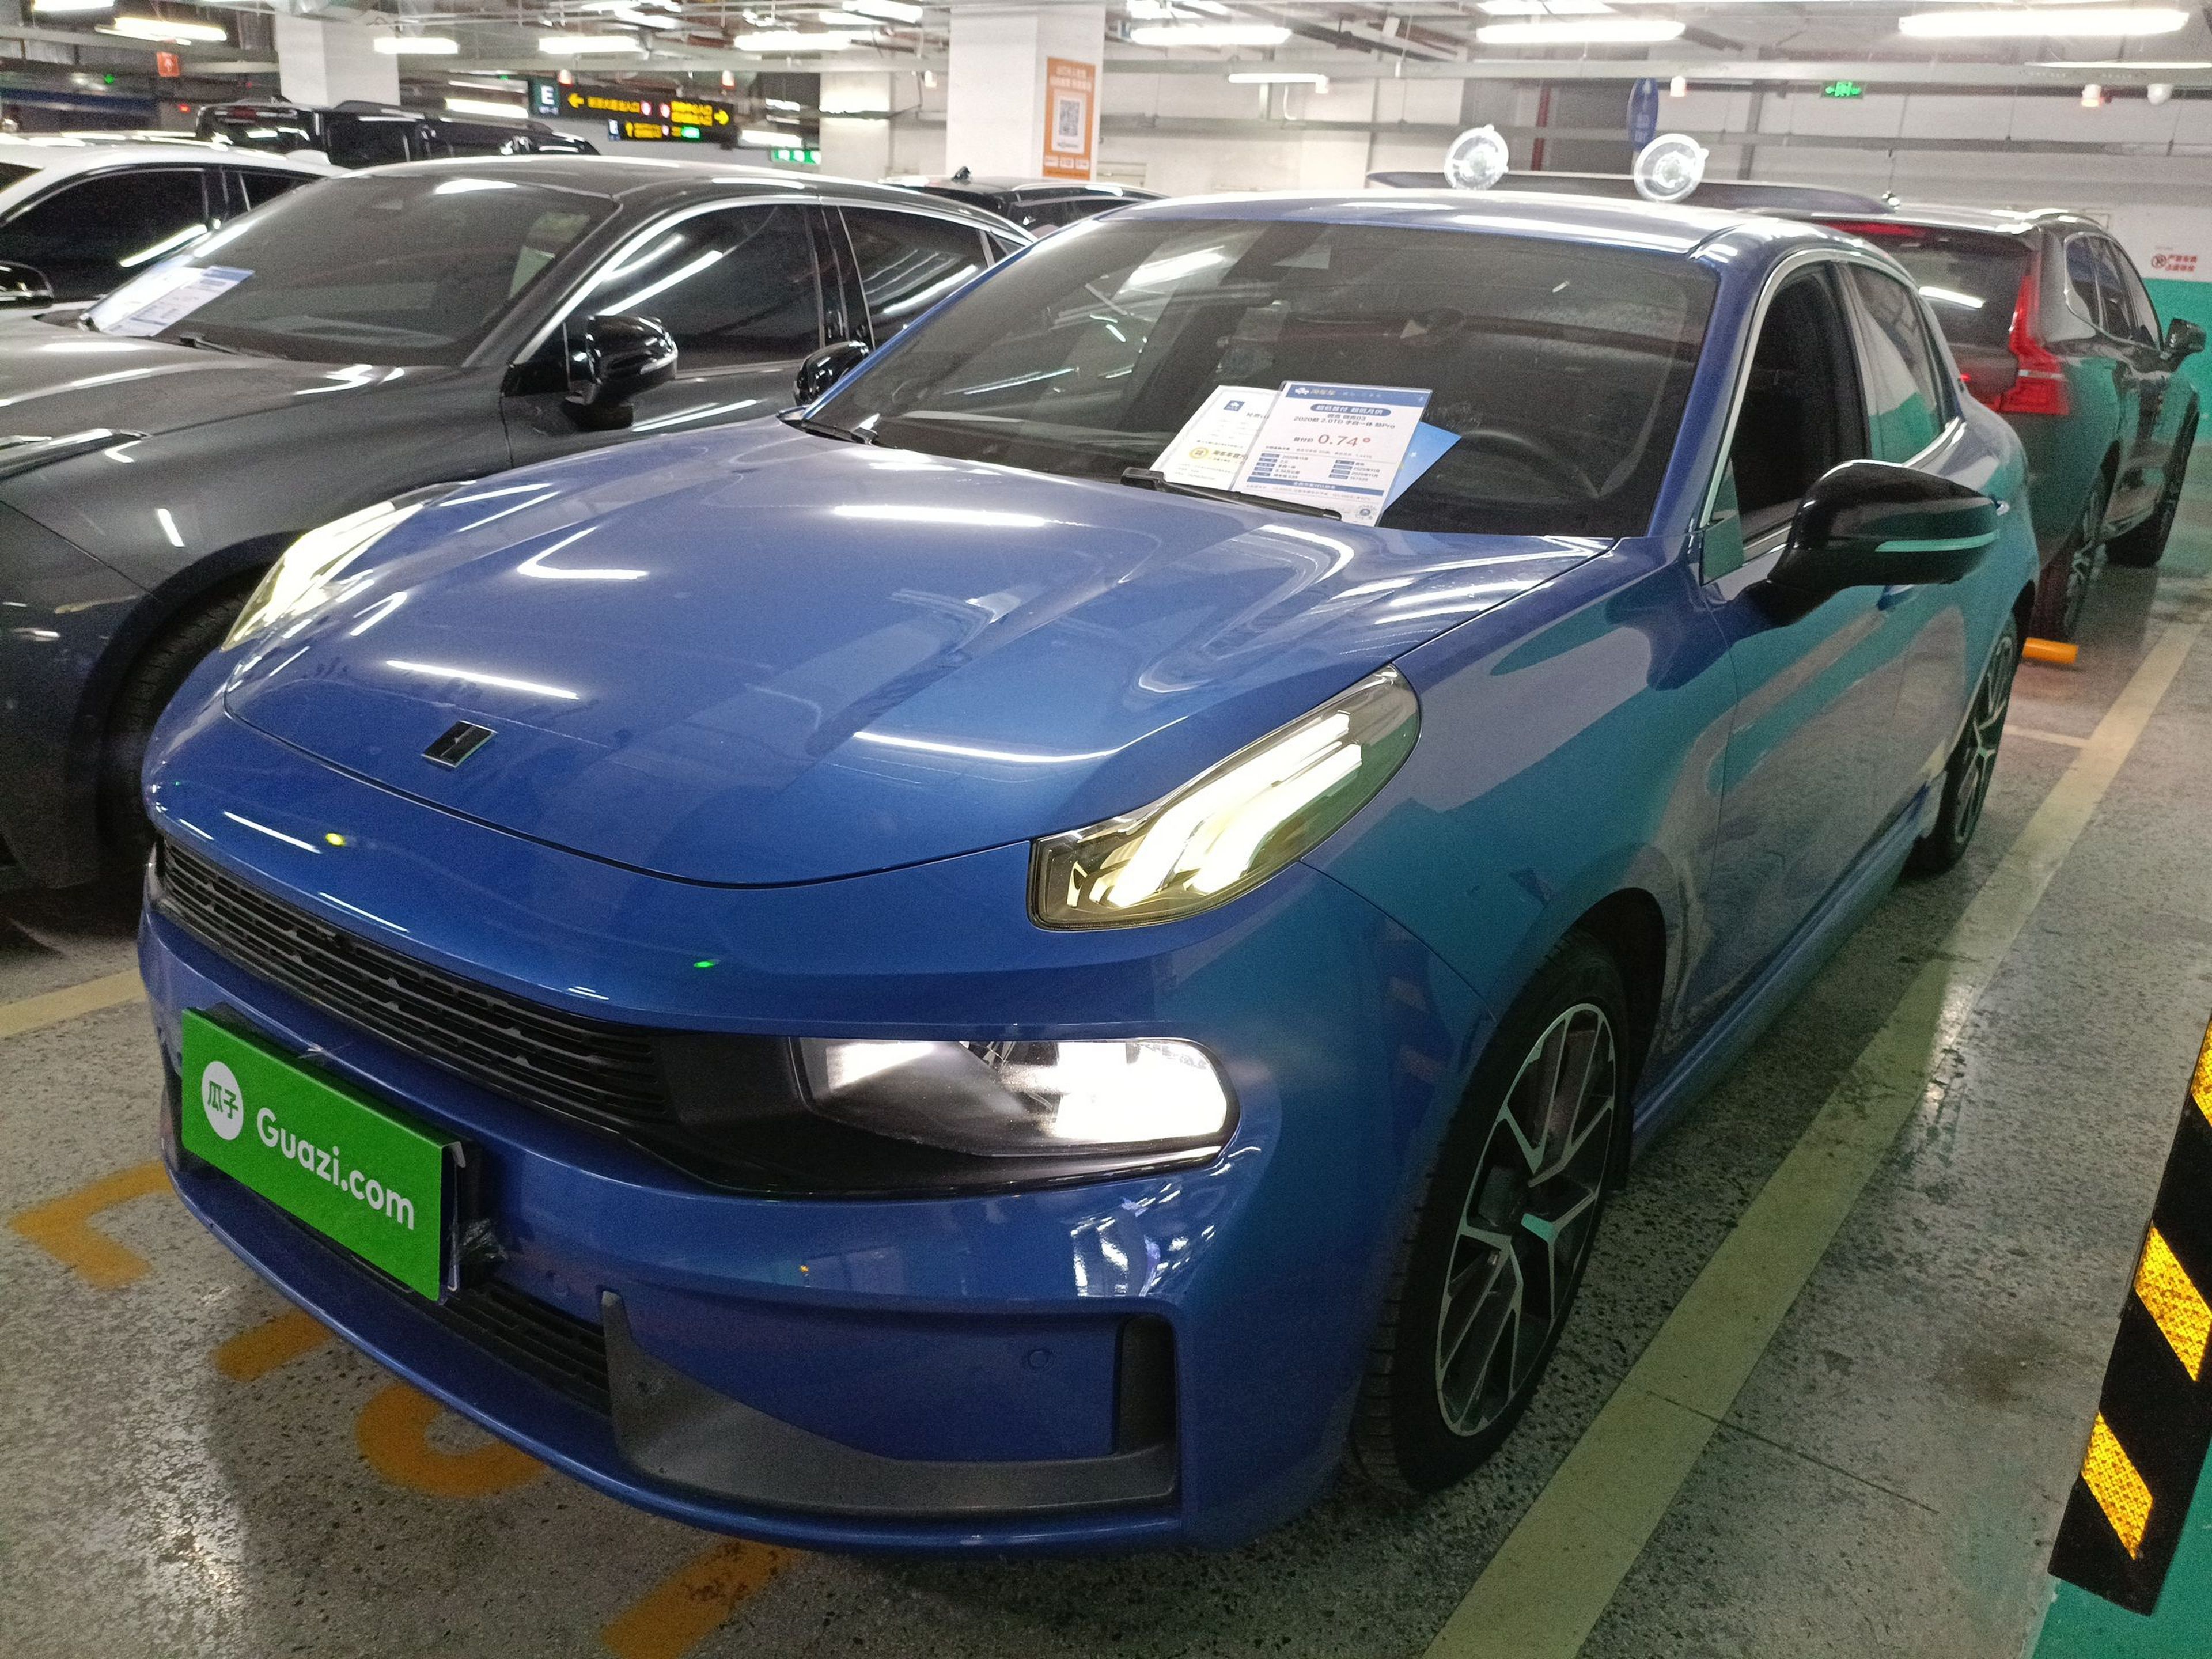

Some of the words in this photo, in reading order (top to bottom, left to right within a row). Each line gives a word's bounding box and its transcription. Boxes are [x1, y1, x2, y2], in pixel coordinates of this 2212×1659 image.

[541, 85, 555, 105] E
[1318, 434, 1358, 447] 0.74
[207, 1081, 239, 1120] 瓜子
[257, 1107, 415, 1231] Guazi.com
